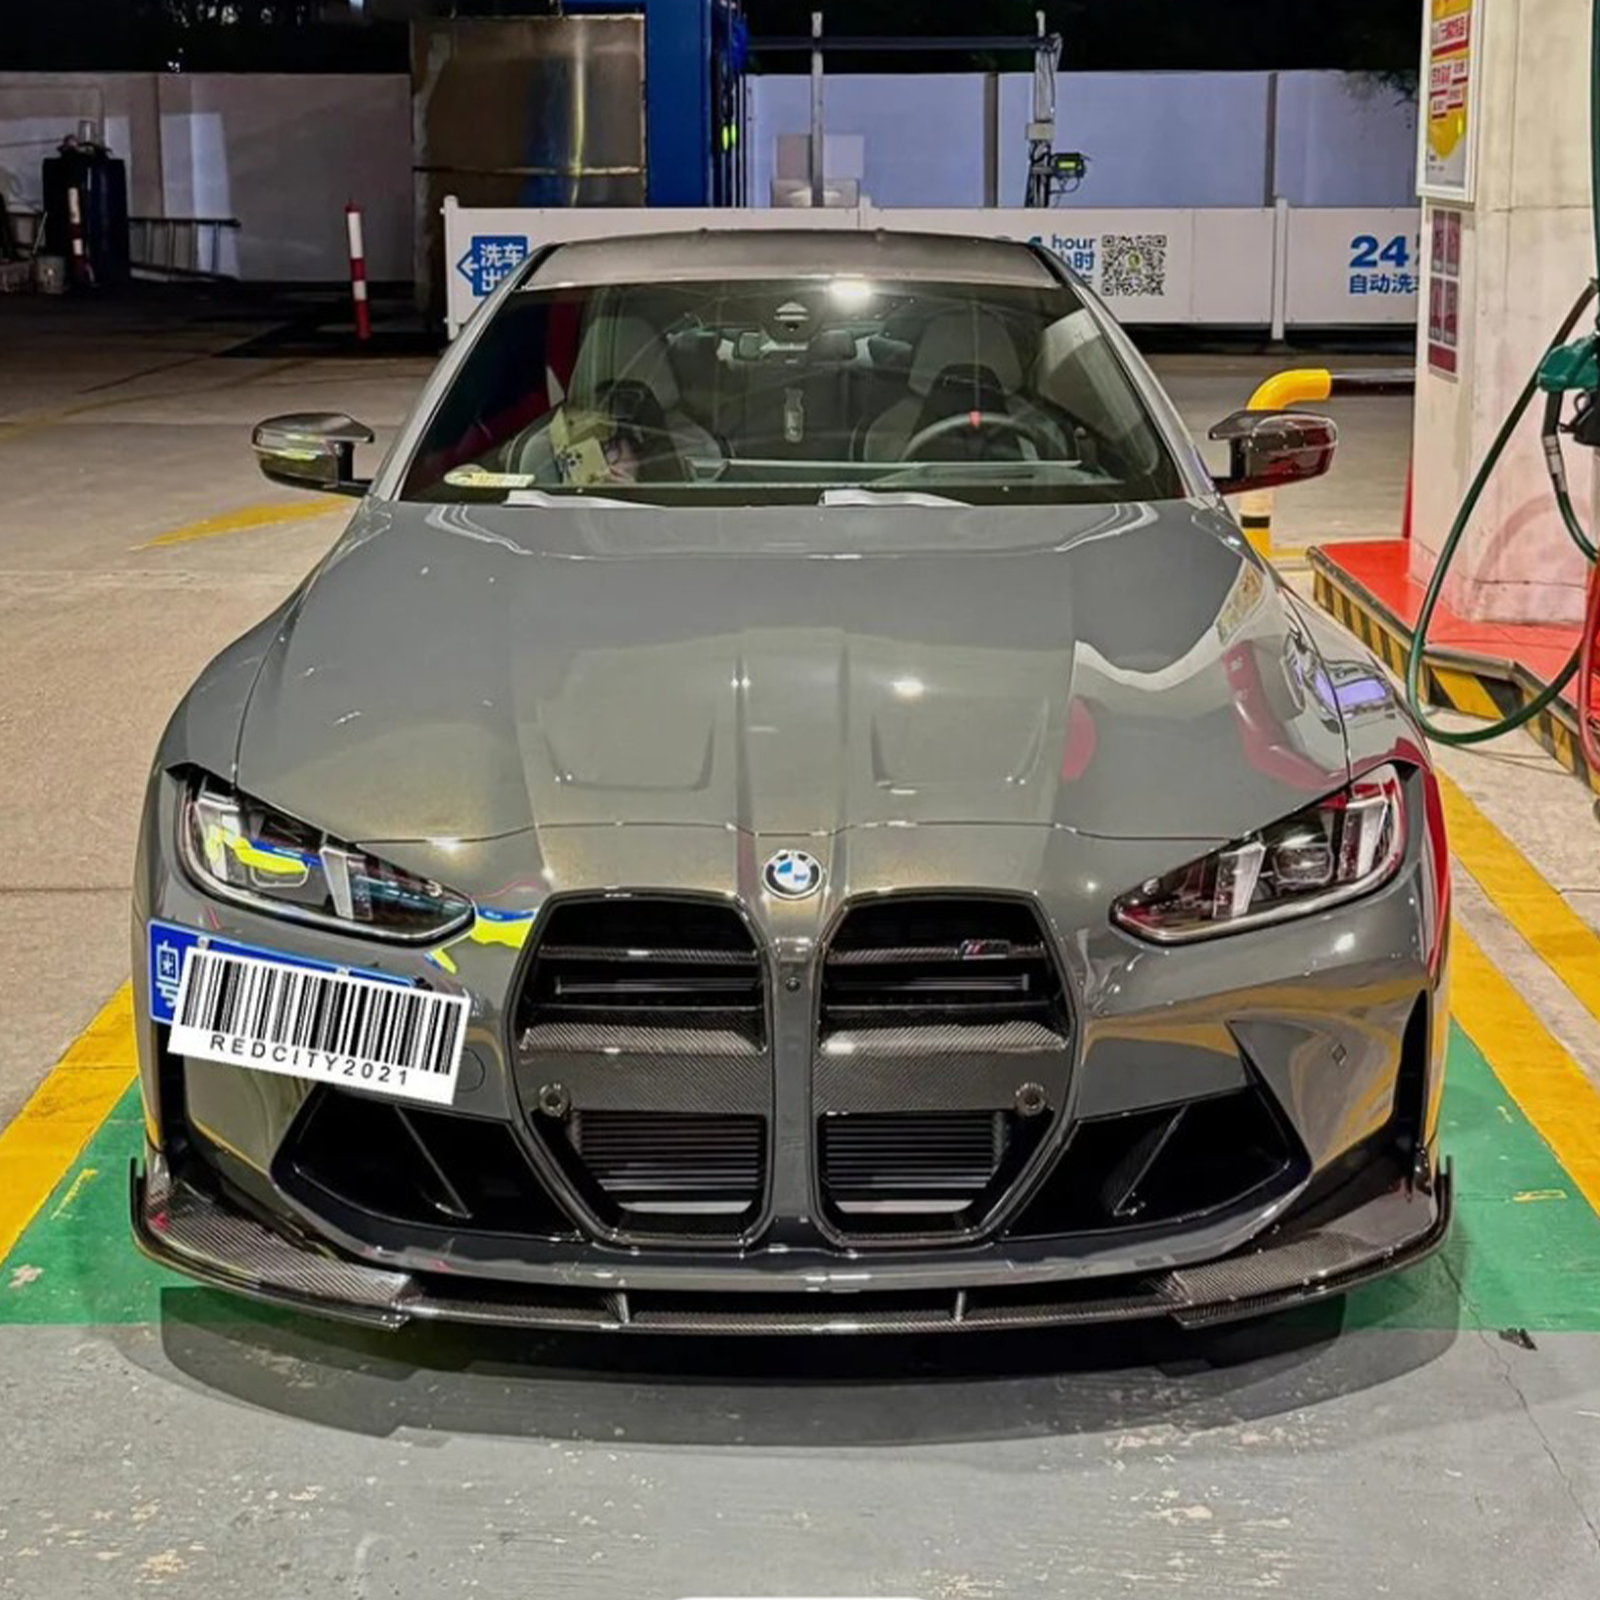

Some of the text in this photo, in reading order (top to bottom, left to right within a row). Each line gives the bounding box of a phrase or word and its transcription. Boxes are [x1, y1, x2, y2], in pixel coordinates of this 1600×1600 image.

[1051, 233, 1095, 249] hour
[1349, 235, 1409, 267] 24
[480, 243, 524, 267] 洗车
[1350, 273, 1418, 293] 自动洗
